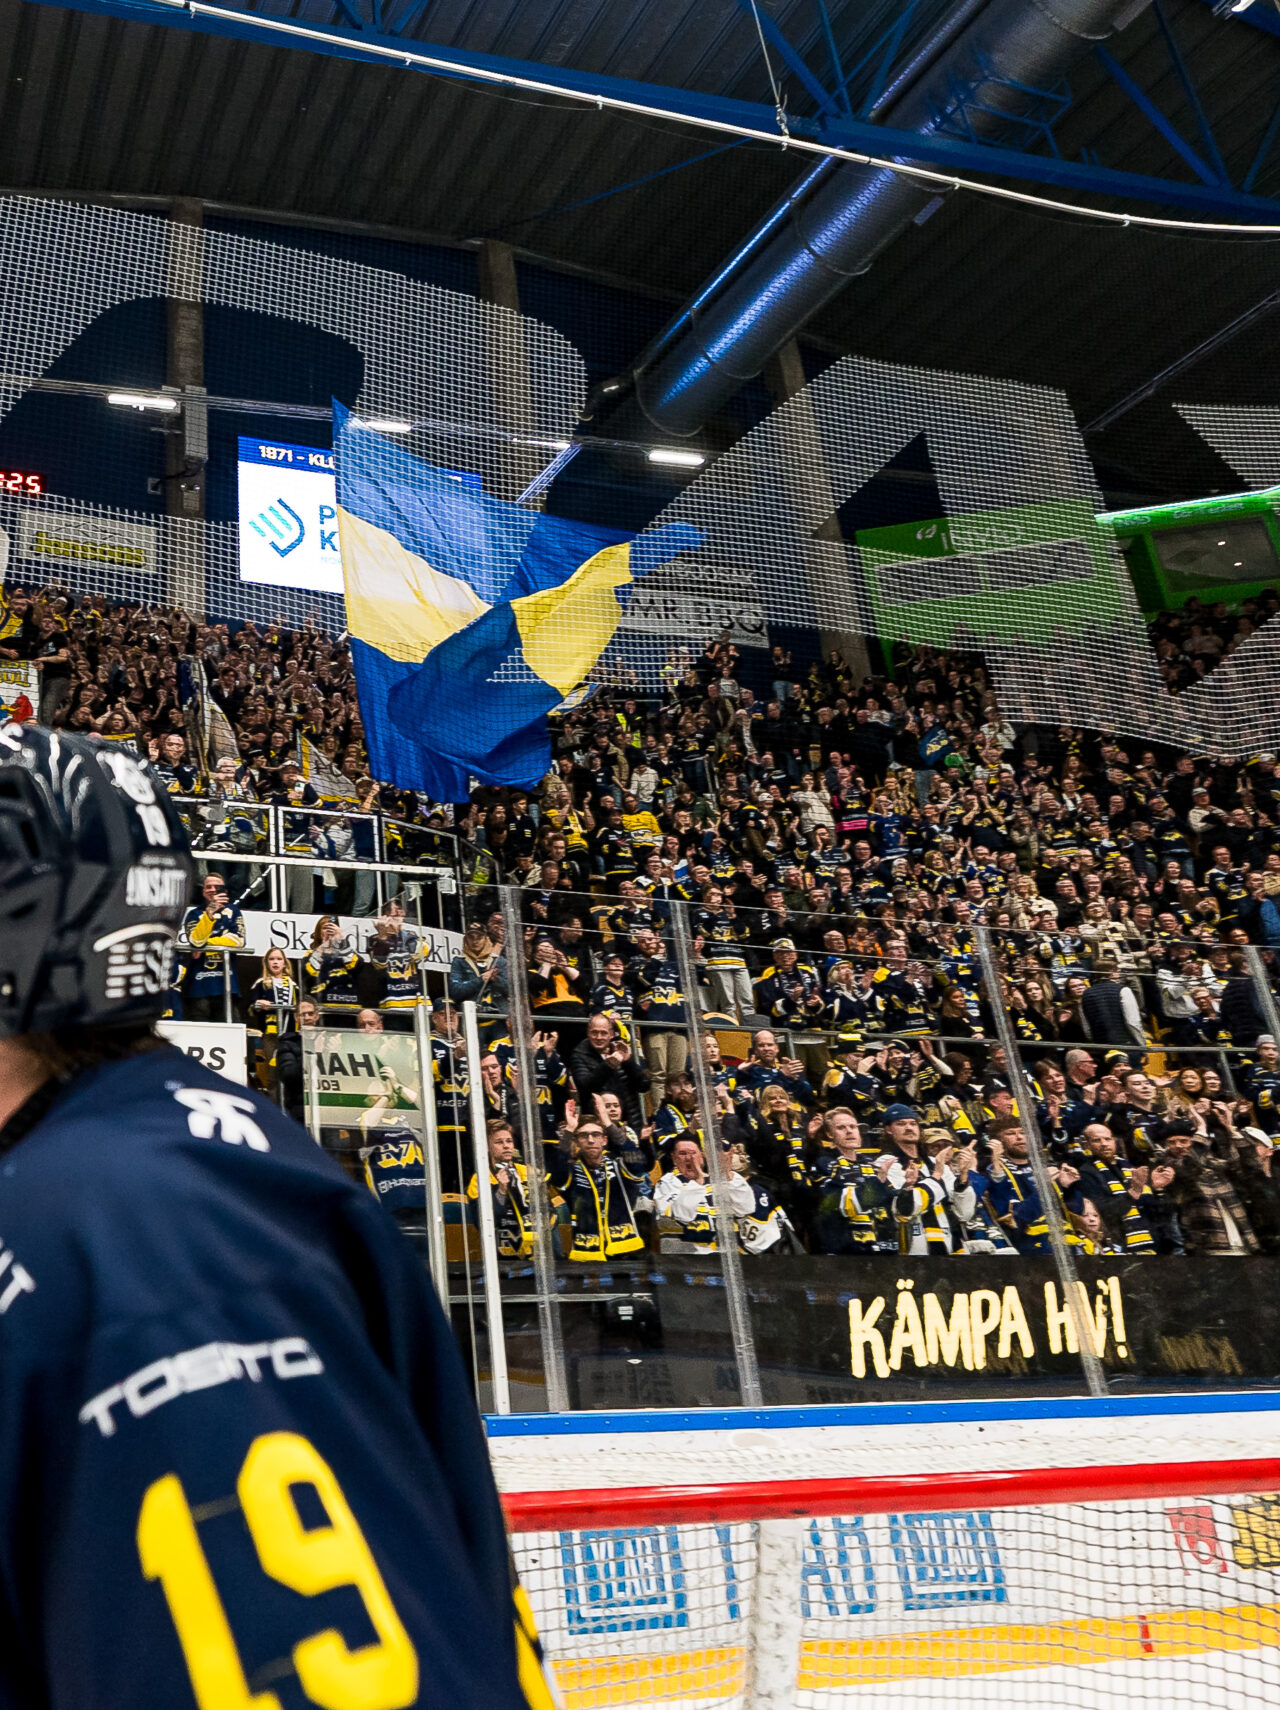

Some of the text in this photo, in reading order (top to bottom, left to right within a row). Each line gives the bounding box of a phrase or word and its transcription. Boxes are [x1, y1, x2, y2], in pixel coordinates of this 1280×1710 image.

[258, 444, 294, 463] 1871
[847, 1278, 1035, 1380] KÄMPA
[137, 1430, 420, 1710] 19
